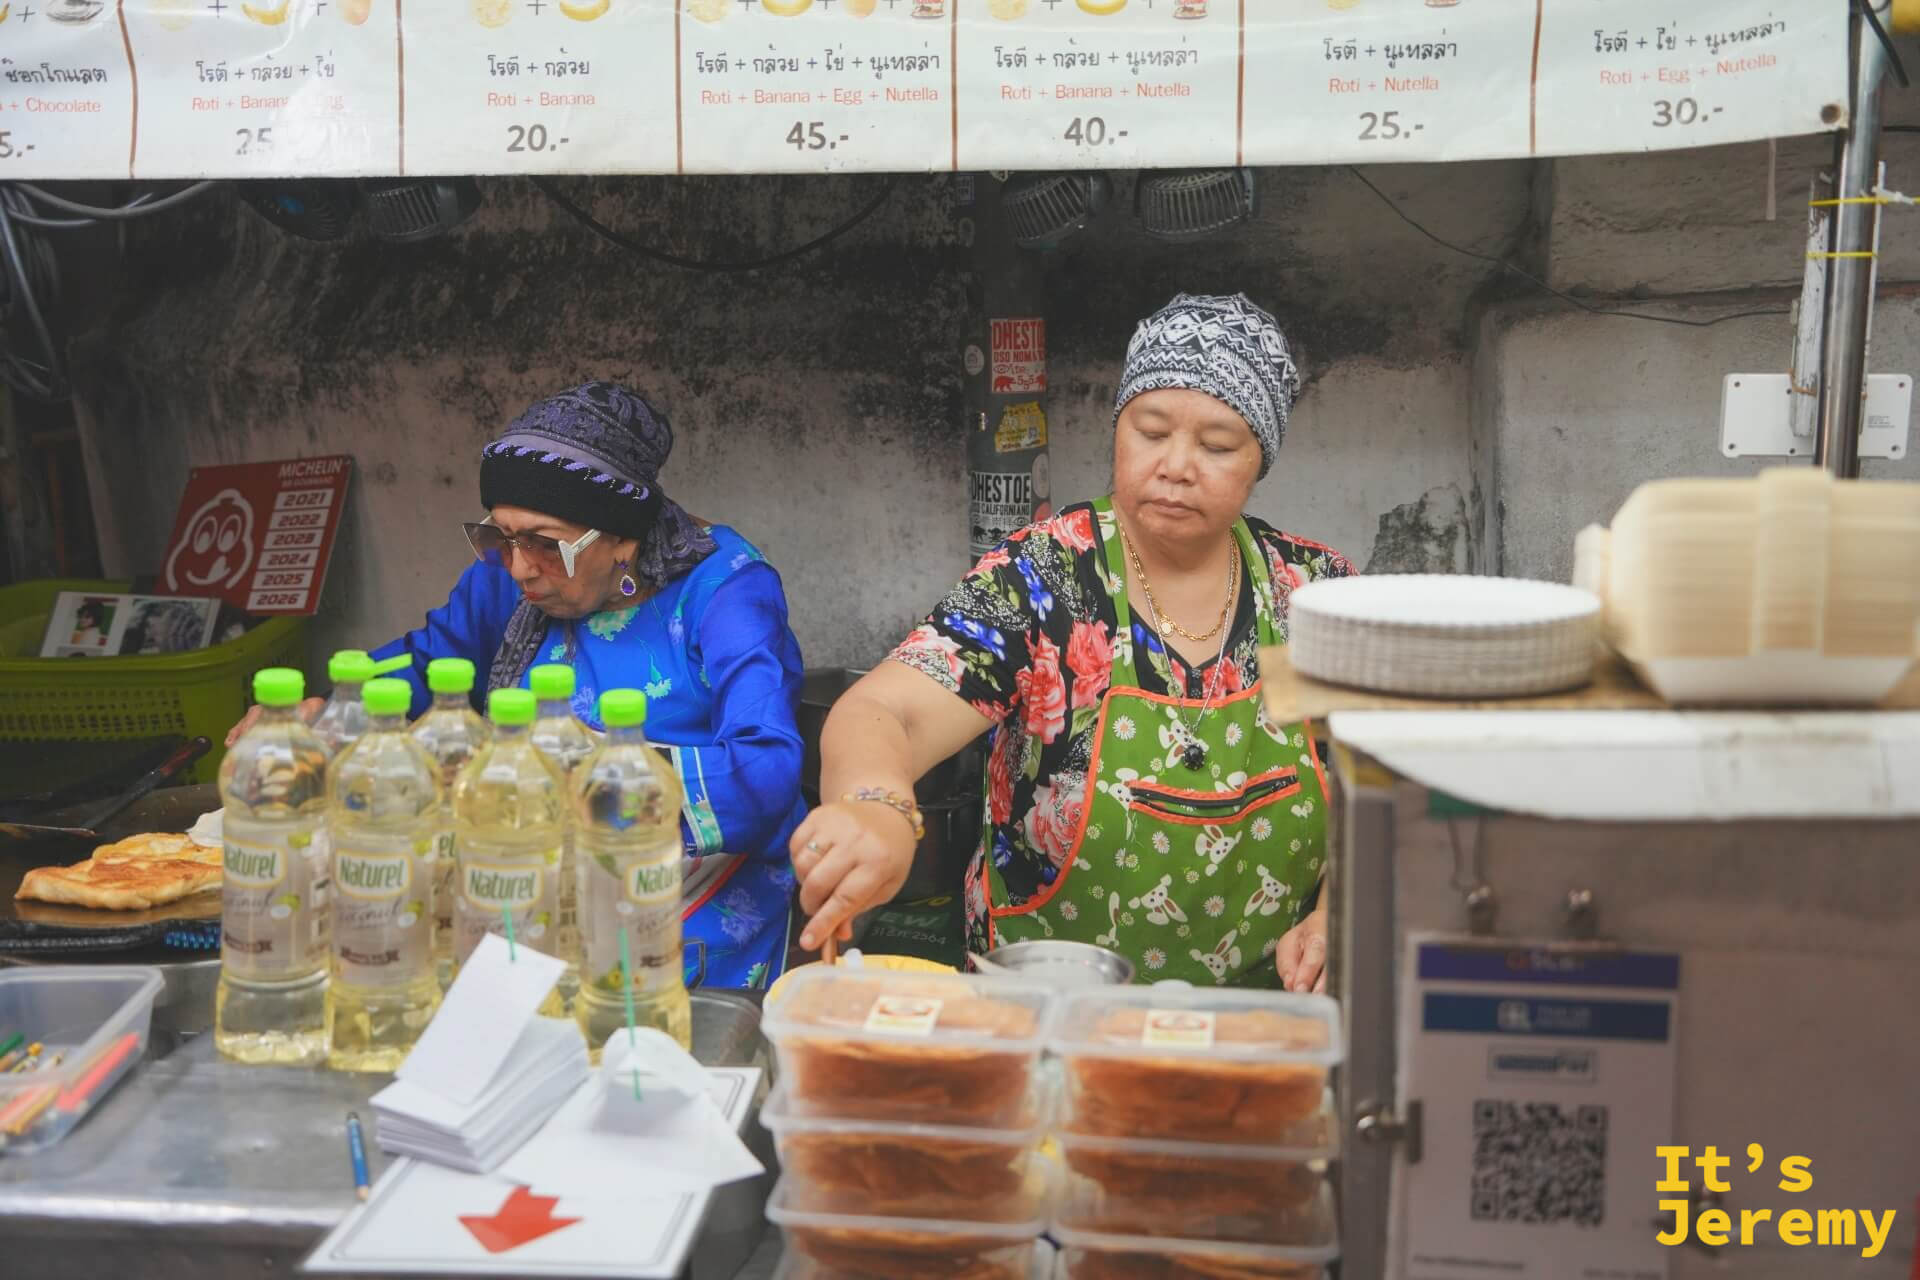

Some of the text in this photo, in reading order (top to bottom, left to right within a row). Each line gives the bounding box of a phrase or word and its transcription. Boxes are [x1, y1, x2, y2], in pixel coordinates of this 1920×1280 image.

[1594, 30, 1628, 53] โรตี
[1656, 22, 1677, 51] ไข่
[1705, 12, 1785, 55] นูเทลล่า
[488, 55, 519, 76] โรตี
[545, 48, 590, 77] กล้วย
[696, 52, 728, 74] โรตี
[753, 44, 799, 74] กล้วย
[825, 44, 844, 71] ไข่
[870, 42, 940, 79] นูเทลล่า
[995, 46, 1027, 68] โรตี
[1053, 38, 1100, 68] กล้วย
[1127, 37, 1198, 75] นูเทลล่า
[1324, 39, 1357, 61] โรตี
[1384, 28, 1457, 69] นูเทลล่า
[196, 61, 228, 83] โรตี
[252, 56, 292, 82] กล้วย
[315, 50, 335, 78] ไข่
[1600, 69, 1632, 85] Roti
[1658, 66, 1690, 84] Egg
[1716, 53, 1777, 75] Nutella
[701, 89, 732, 104] Roti
[754, 88, 811, 104] Banana
[833, 87, 862, 105] Egg
[886, 86, 939, 103] Nutella
[1001, 84, 1032, 100] Roti
[1055, 83, 1113, 99] Banana
[1137, 81, 1191, 97] Nutella
[1328, 77, 1361, 93] Roti
[1384, 76, 1439, 92] Nutella
[25, 97, 101, 112] Chocolate
[192, 97, 219, 111] Roti
[487, 92, 516, 106] Roti
[540, 92, 596, 106] Banana
[1653, 98, 1724, 127] 30.-
[507, 124, 570, 152] 20.-
[786, 121, 849, 150] 45.-
[1064, 116, 1129, 146] 40.-
[1358, 111, 1424, 140] 25.-
[279, 458, 342, 478] MICHELIN
[283, 492, 327, 507] 2021
[278, 513, 321, 527] 2022
[267, 553, 309, 566] 2024
[262, 573, 304, 586] 2025
[256, 593, 300, 606] 2026
[340, 856, 404, 888] Naturel
[470, 870, 536, 899] Naturel
